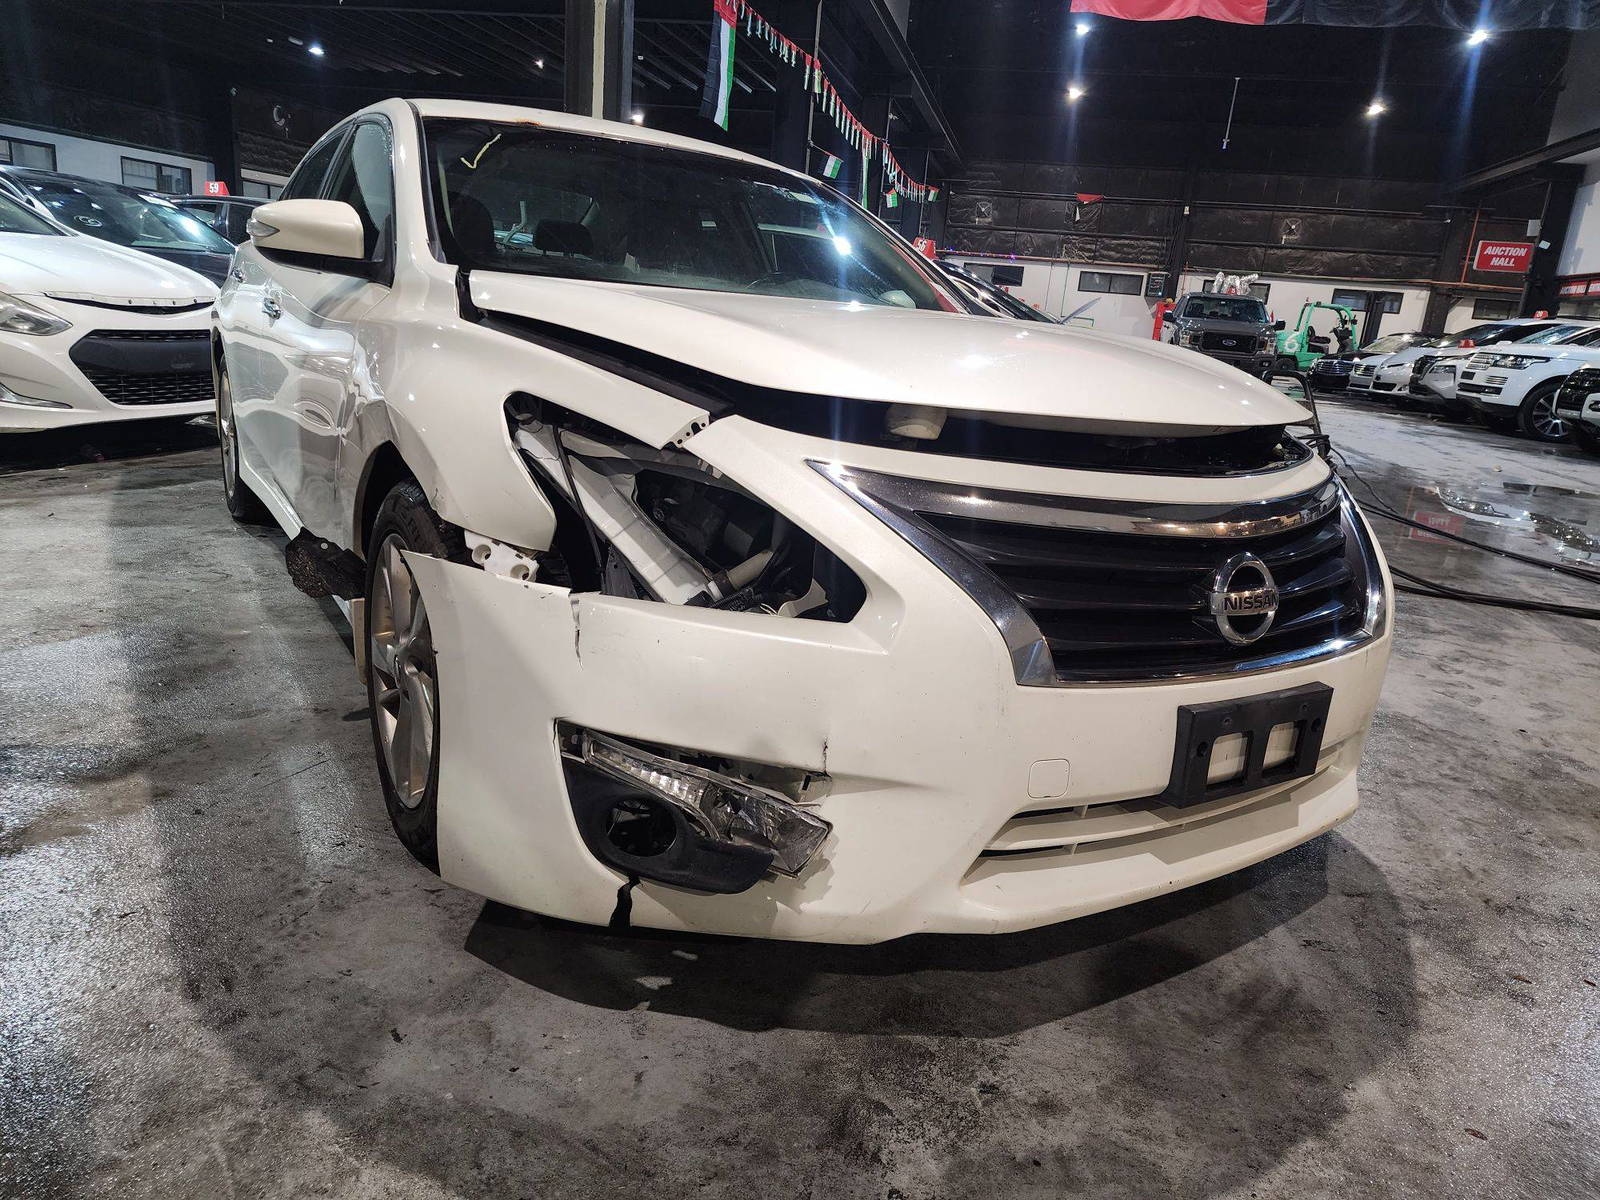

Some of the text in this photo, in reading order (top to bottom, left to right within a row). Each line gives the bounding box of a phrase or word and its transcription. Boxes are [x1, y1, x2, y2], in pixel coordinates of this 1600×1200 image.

[209, 182, 219, 193] 59
[1484, 246, 1527, 256] AUCTION
[1490, 257, 1515, 266] HALL
[1284, 331, 1300, 352] 6
[1223, 590, 1278, 610] NISSAN
